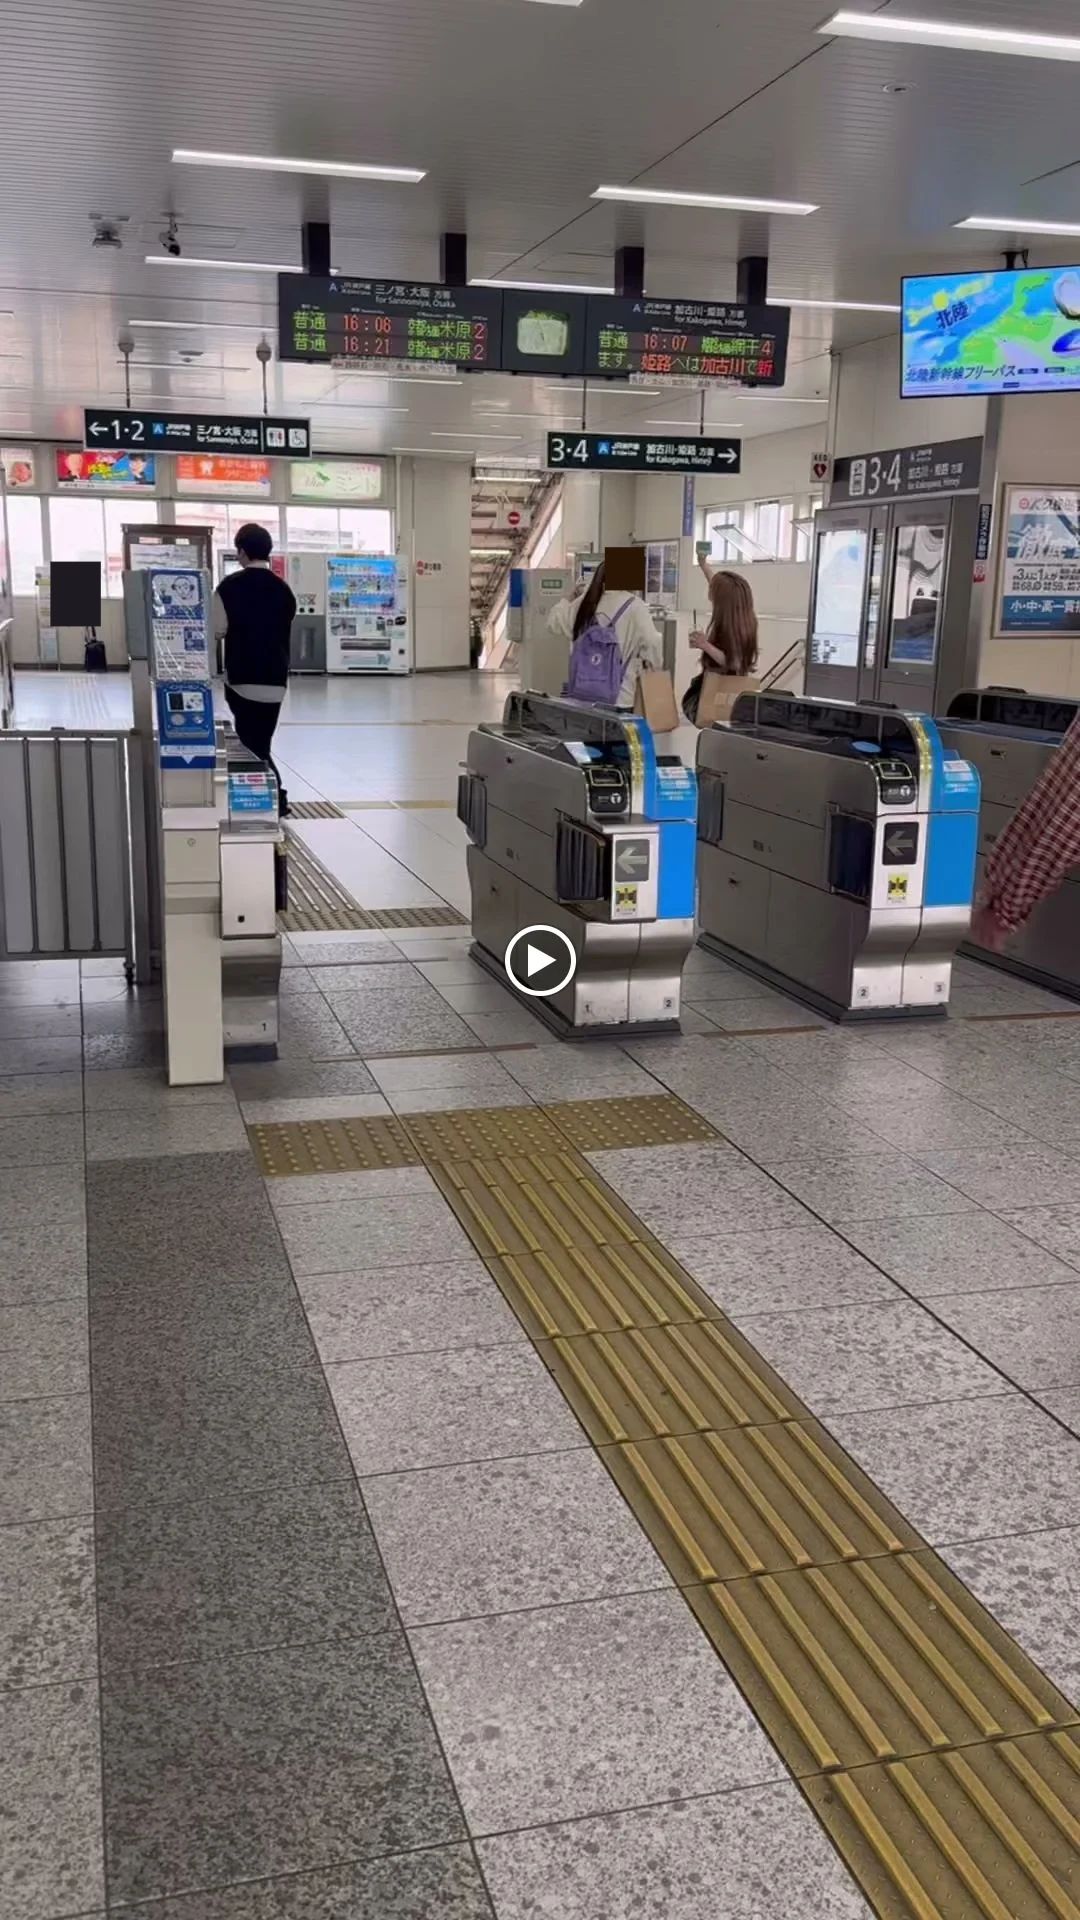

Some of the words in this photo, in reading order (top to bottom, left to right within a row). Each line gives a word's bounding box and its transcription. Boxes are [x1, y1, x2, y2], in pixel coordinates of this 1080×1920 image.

[376, 284, 430, 297] 三ノ宮・大阪
[293, 311, 327, 329] 普通
[440, 320, 472, 339] 米原
[474, 323, 485, 339] 2
[935, 301, 968, 330] 北陸
[293, 333, 327, 351] 普通
[344, 336, 390, 354] 16:21
[440, 342, 472, 360] 米原
[473, 344, 484, 360] 2
[599, 331, 628, 348] 普通
[762, 340, 771, 356] 4
[905, 366, 1016, 382] 北陸新幹線フリーパス
